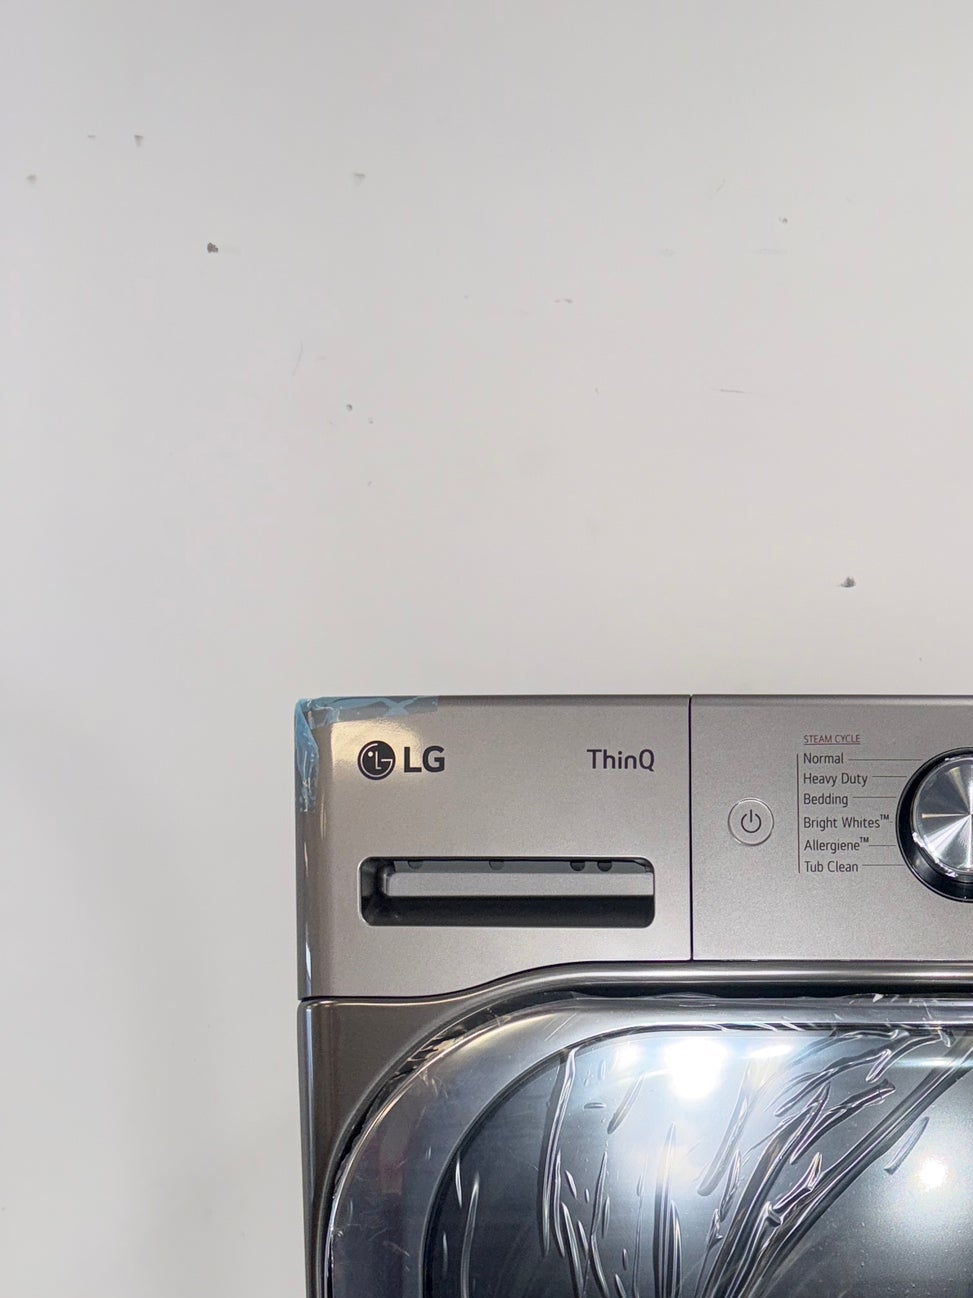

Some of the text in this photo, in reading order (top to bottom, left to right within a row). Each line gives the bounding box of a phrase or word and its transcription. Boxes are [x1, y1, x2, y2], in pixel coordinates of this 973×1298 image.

[803, 734, 861, 745] STEAM CYCLE
[403, 746, 446, 773] LG
[586, 748, 656, 771] ThinQ
[803, 752, 844, 765] Normal
[803, 772, 868, 788] Heavy Duty
[803, 793, 849, 808] Bedding
[803, 816, 838, 831] Bright
[804, 860, 859, 873] Tub Clean
